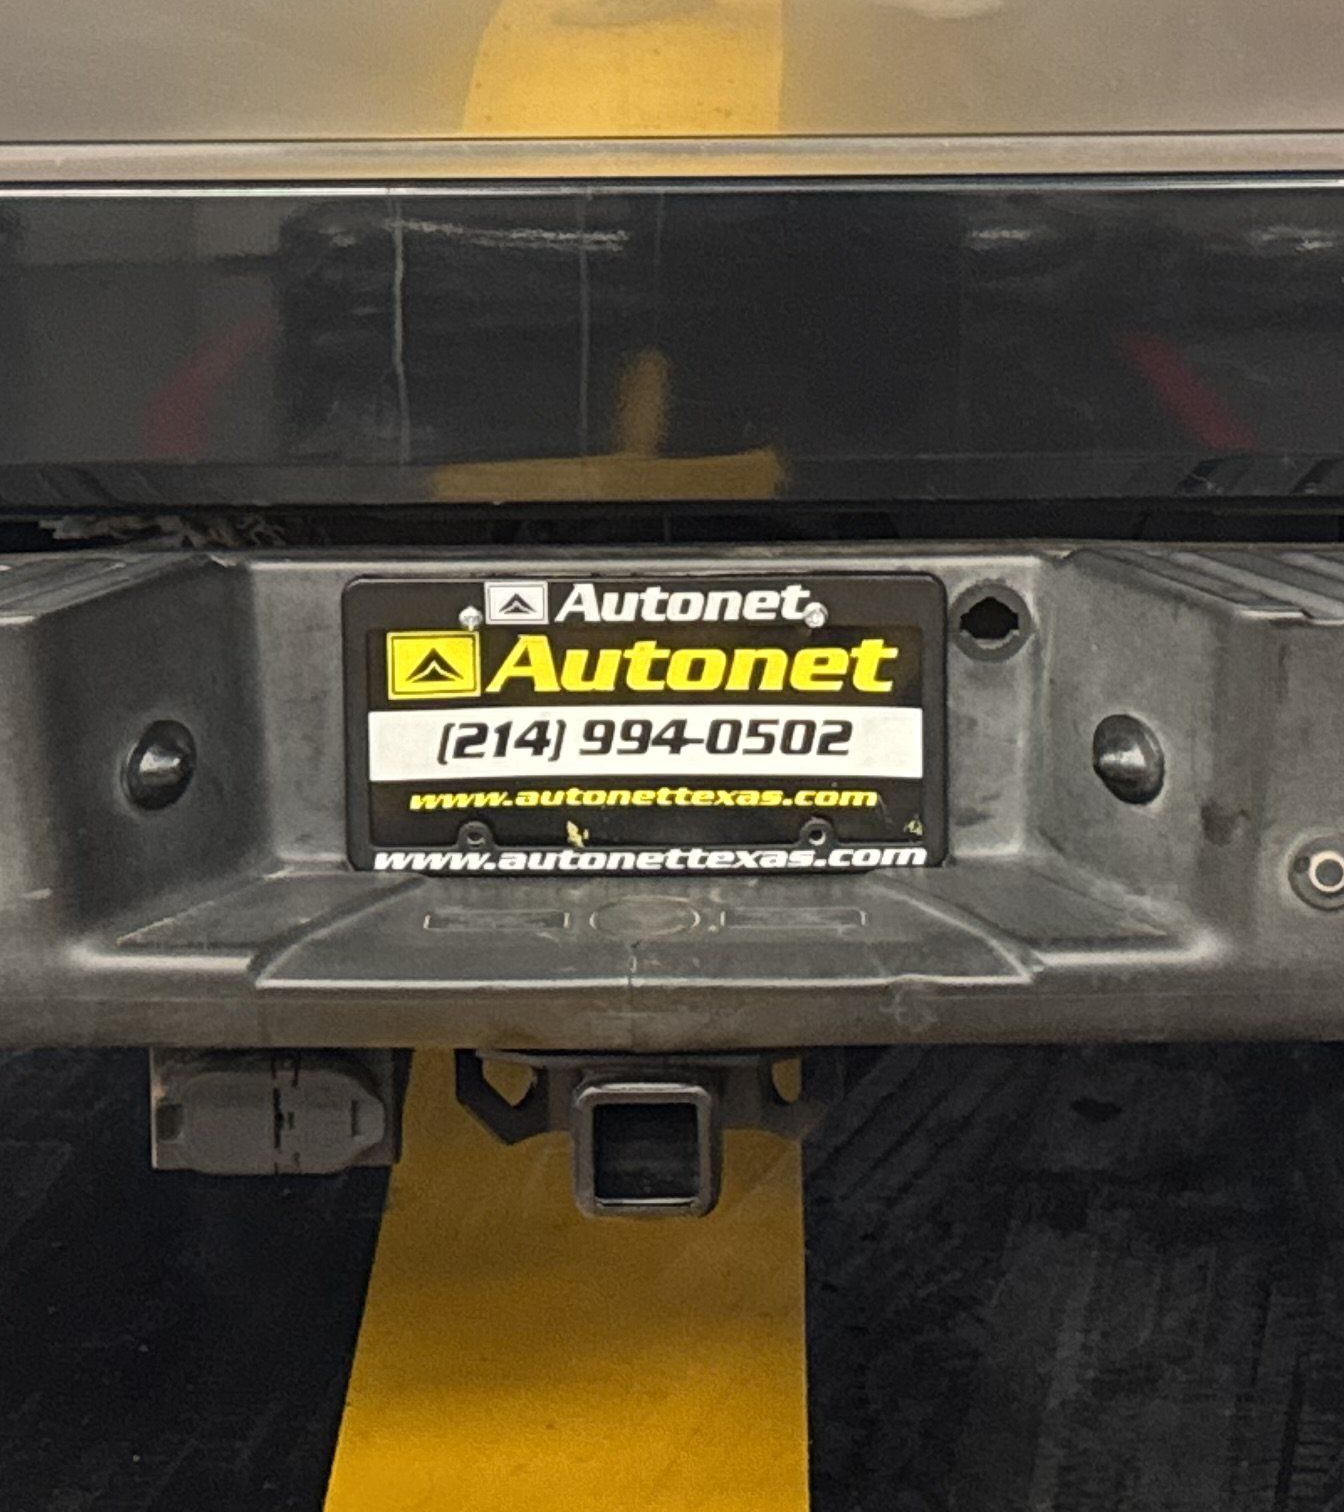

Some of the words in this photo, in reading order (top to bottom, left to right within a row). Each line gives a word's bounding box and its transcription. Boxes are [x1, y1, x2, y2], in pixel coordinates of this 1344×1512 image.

[555, 582, 812, 623] Autonet
[486, 634, 899, 693] Autonet
[437, 721, 566, 765] (214)
[579, 718, 854, 757] 994-0502
[408, 787, 879, 811] www.autonettexas.com
[372, 845, 929, 873] www.autonettexas.com
